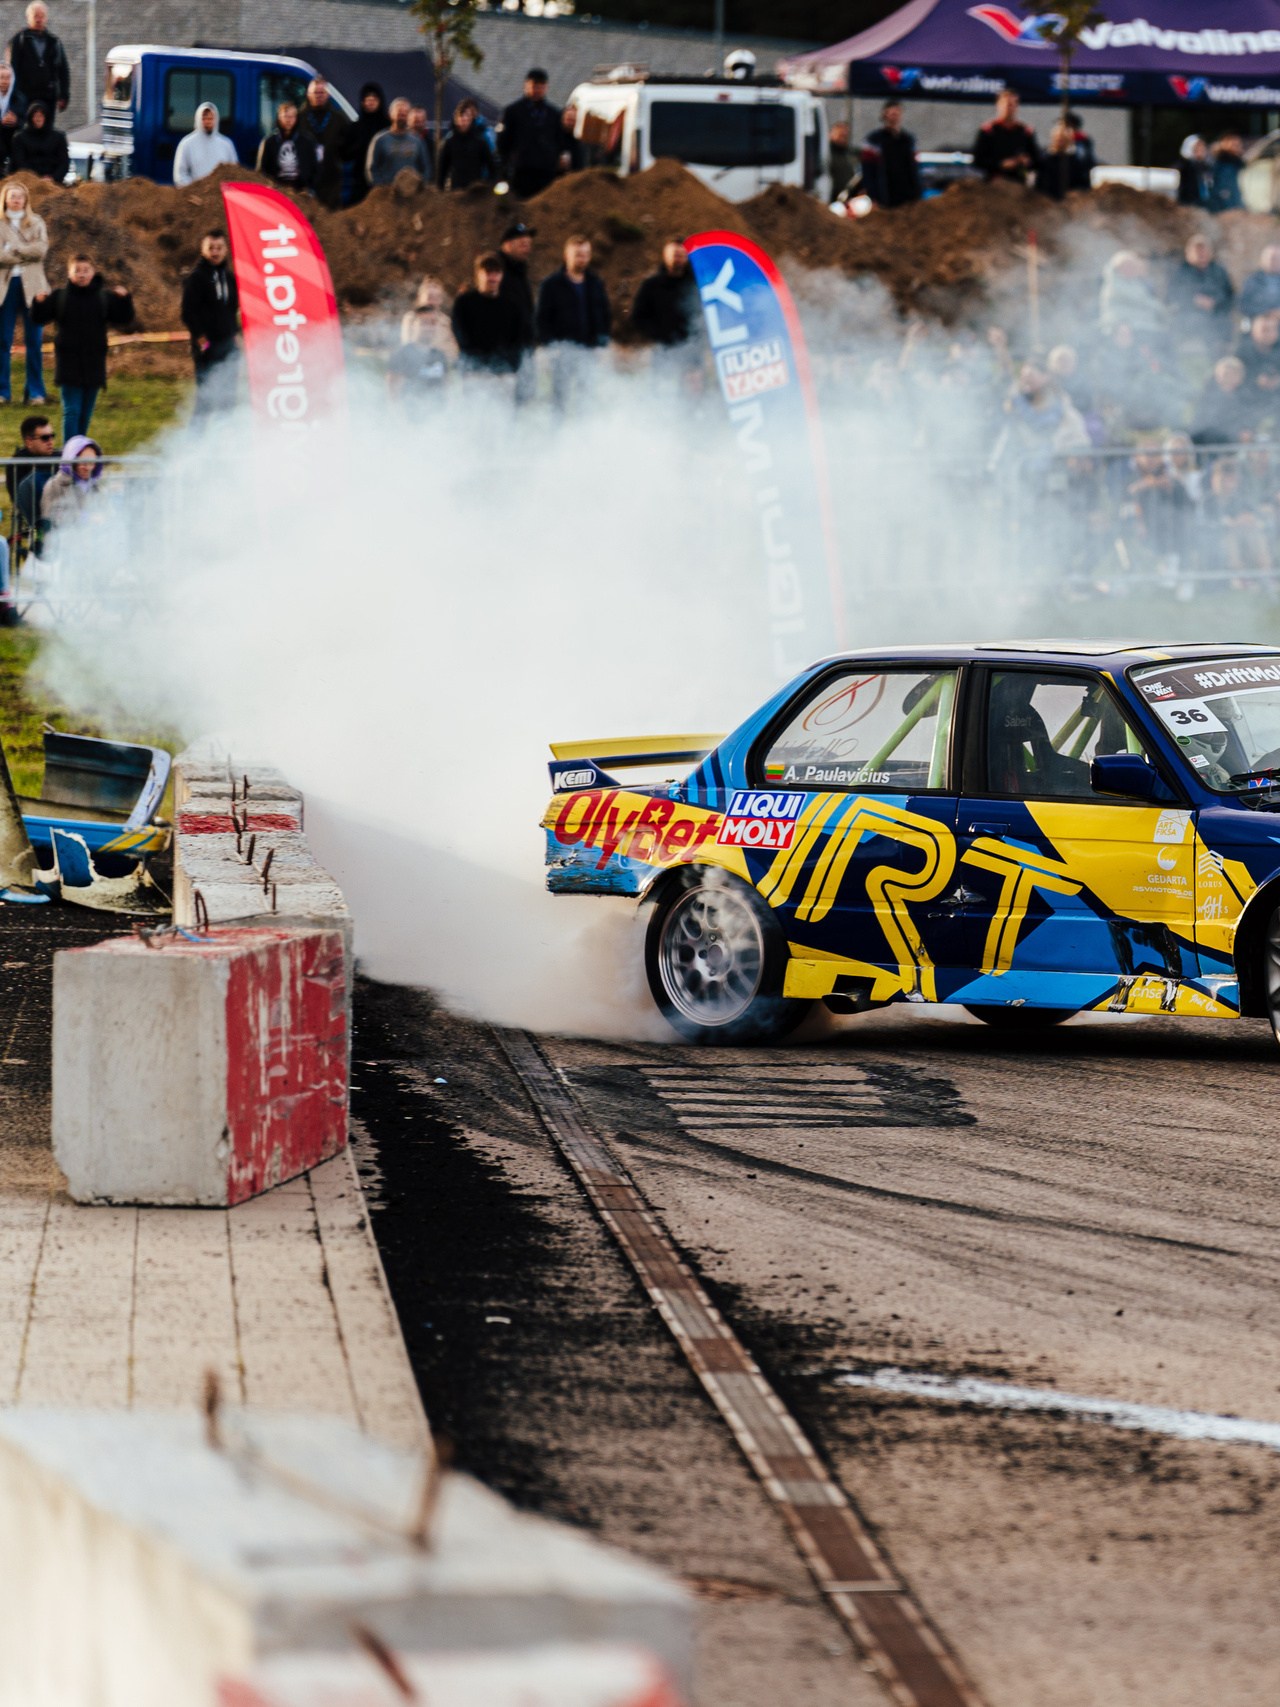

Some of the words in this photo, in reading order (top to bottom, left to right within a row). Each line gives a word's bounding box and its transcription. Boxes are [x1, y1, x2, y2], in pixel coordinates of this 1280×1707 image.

[1142, 681, 1164, 694] ONE
[1152, 686, 1173, 697] WAY
[1170, 709, 1208, 725] 36
[784, 765, 800, 781] A.
[730, 793, 802, 819] LIQUI
[554, 789, 727, 871] OlyBet
[1156, 828, 1176, 836] FIKSA
[1157, 821, 1174, 829] ART
[720, 819, 795, 847] MOLY
[1147, 874, 1187, 885] GEDARTA
